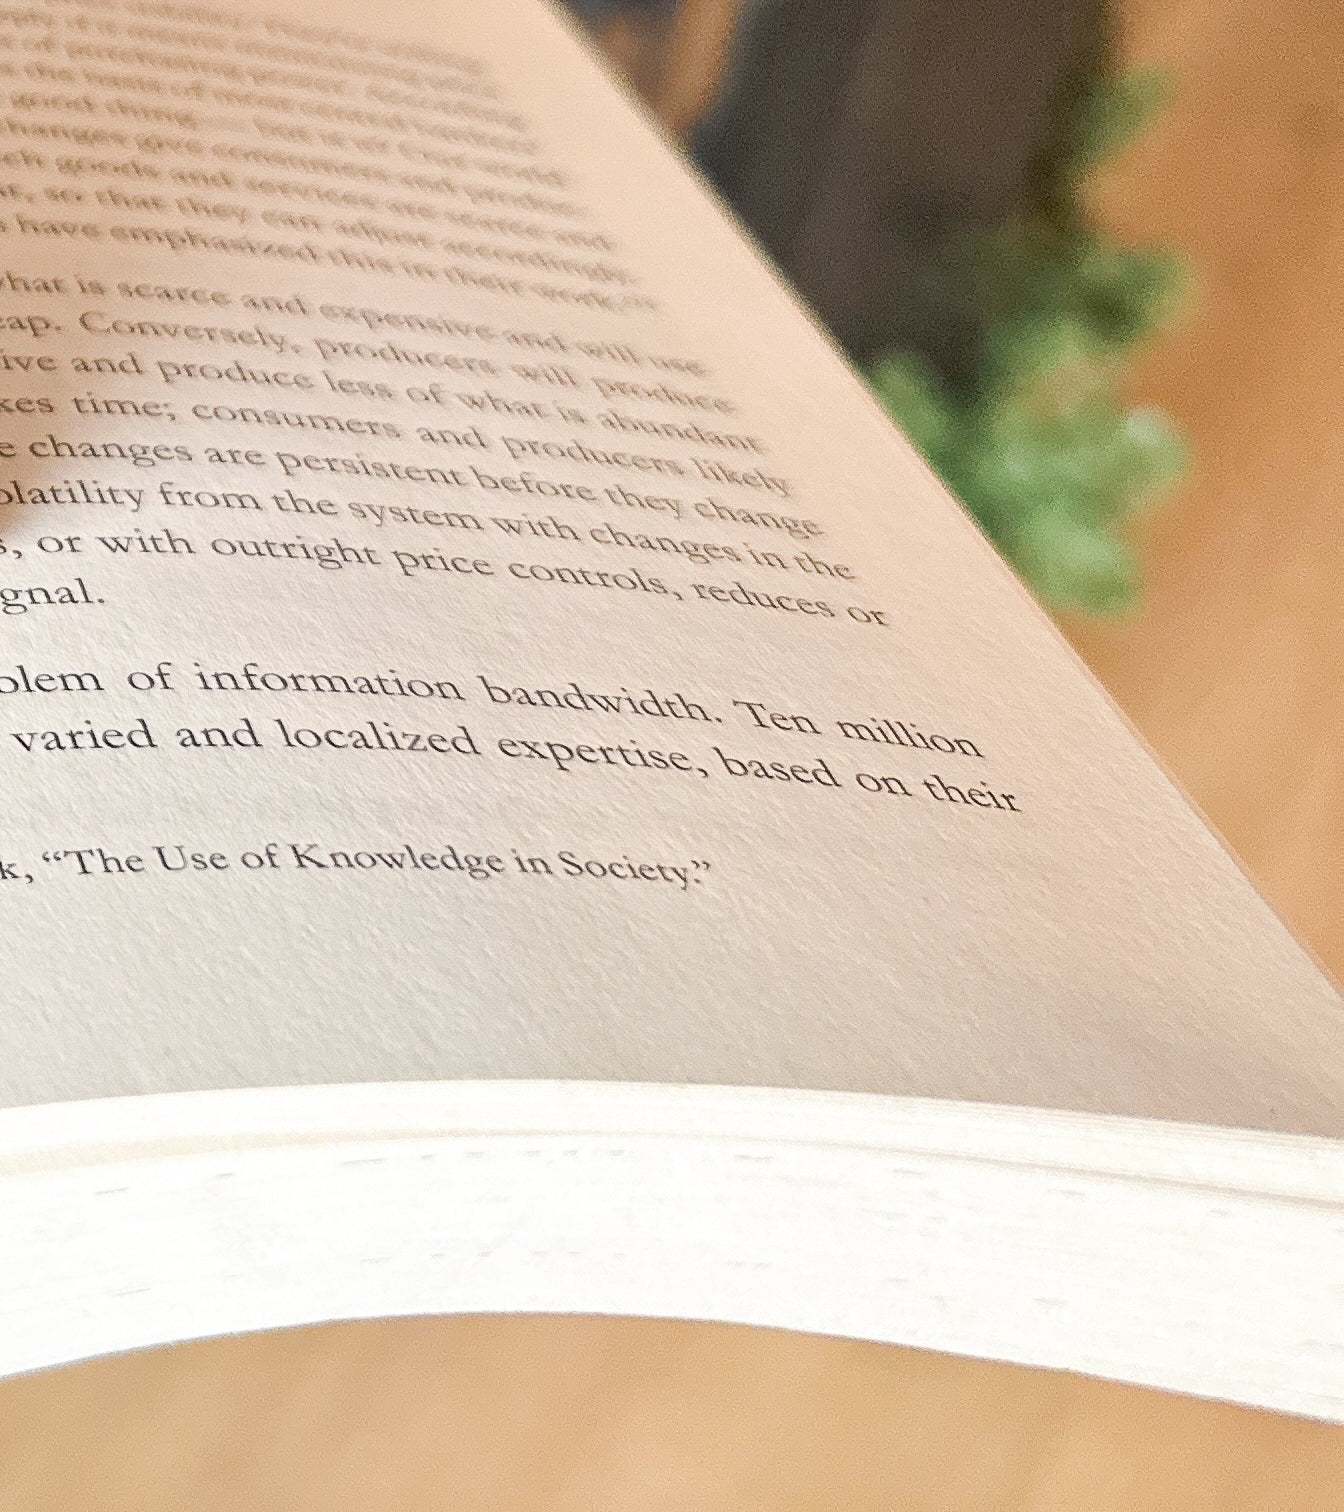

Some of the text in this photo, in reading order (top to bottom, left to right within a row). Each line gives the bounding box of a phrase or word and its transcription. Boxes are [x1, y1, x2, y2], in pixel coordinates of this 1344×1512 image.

[241, 294, 311, 317] and
[71, 352, 145, 375] and
[155, 360, 315, 390] produce
[321, 370, 397, 402] less
[406, 383, 446, 407] of
[455, 390, 550, 419] what
[556, 406, 591, 426] is
[596, 409, 769, 455] abundant
[79, 311, 303, 356] Conversely,
[313, 338, 501, 377] producers
[510, 365, 581, 390] will
[590, 377, 738, 416] produce
[29, 434, 825, 540] changes are persistent before they change
[72, 392, 176, 421] time;
[191, 404, 403, 440] consumers
[416, 426, 489, 449] and
[500, 436, 687, 477] producers
[690, 457, 792, 499] likely
[37, 536, 82, 553] or
[96, 528, 196, 554] with
[211, 538, 381, 570] outright
[391, 548, 494, 577] price
[508, 563, 684, 601] controls,
[690, 581, 836, 617] reduces
[846, 607, 889, 627] or
[158, 482, 263, 511] from
[271, 489, 338, 516] the
[348, 502, 485, 531] system
[489, 516, 582, 542] with
[589, 522, 743, 565] changes
[747, 549, 790, 571] in
[793, 552, 856, 582] the
[127, 662, 174, 691] of
[194, 662, 466, 701] information
[477, 675, 722, 723] bandwidth.
[732, 699, 822, 735] Ten
[836, 718, 985, 758] million
[11, 718, 158, 752] varied
[176, 718, 263, 748] and
[274, 719, 482, 755] localized
[498, 739, 709, 778] expertise,
[712, 747, 843, 787] based
[856, 773, 913, 797] on
[922, 774, 1022, 812] their
[42, 848, 145, 875] “The
[152, 845, 229, 871] Use
[241, 843, 280, 869] of
[288, 844, 505, 880] Knowledge
[511, 849, 554, 875] in
[558, 851, 711, 891] Society.”
